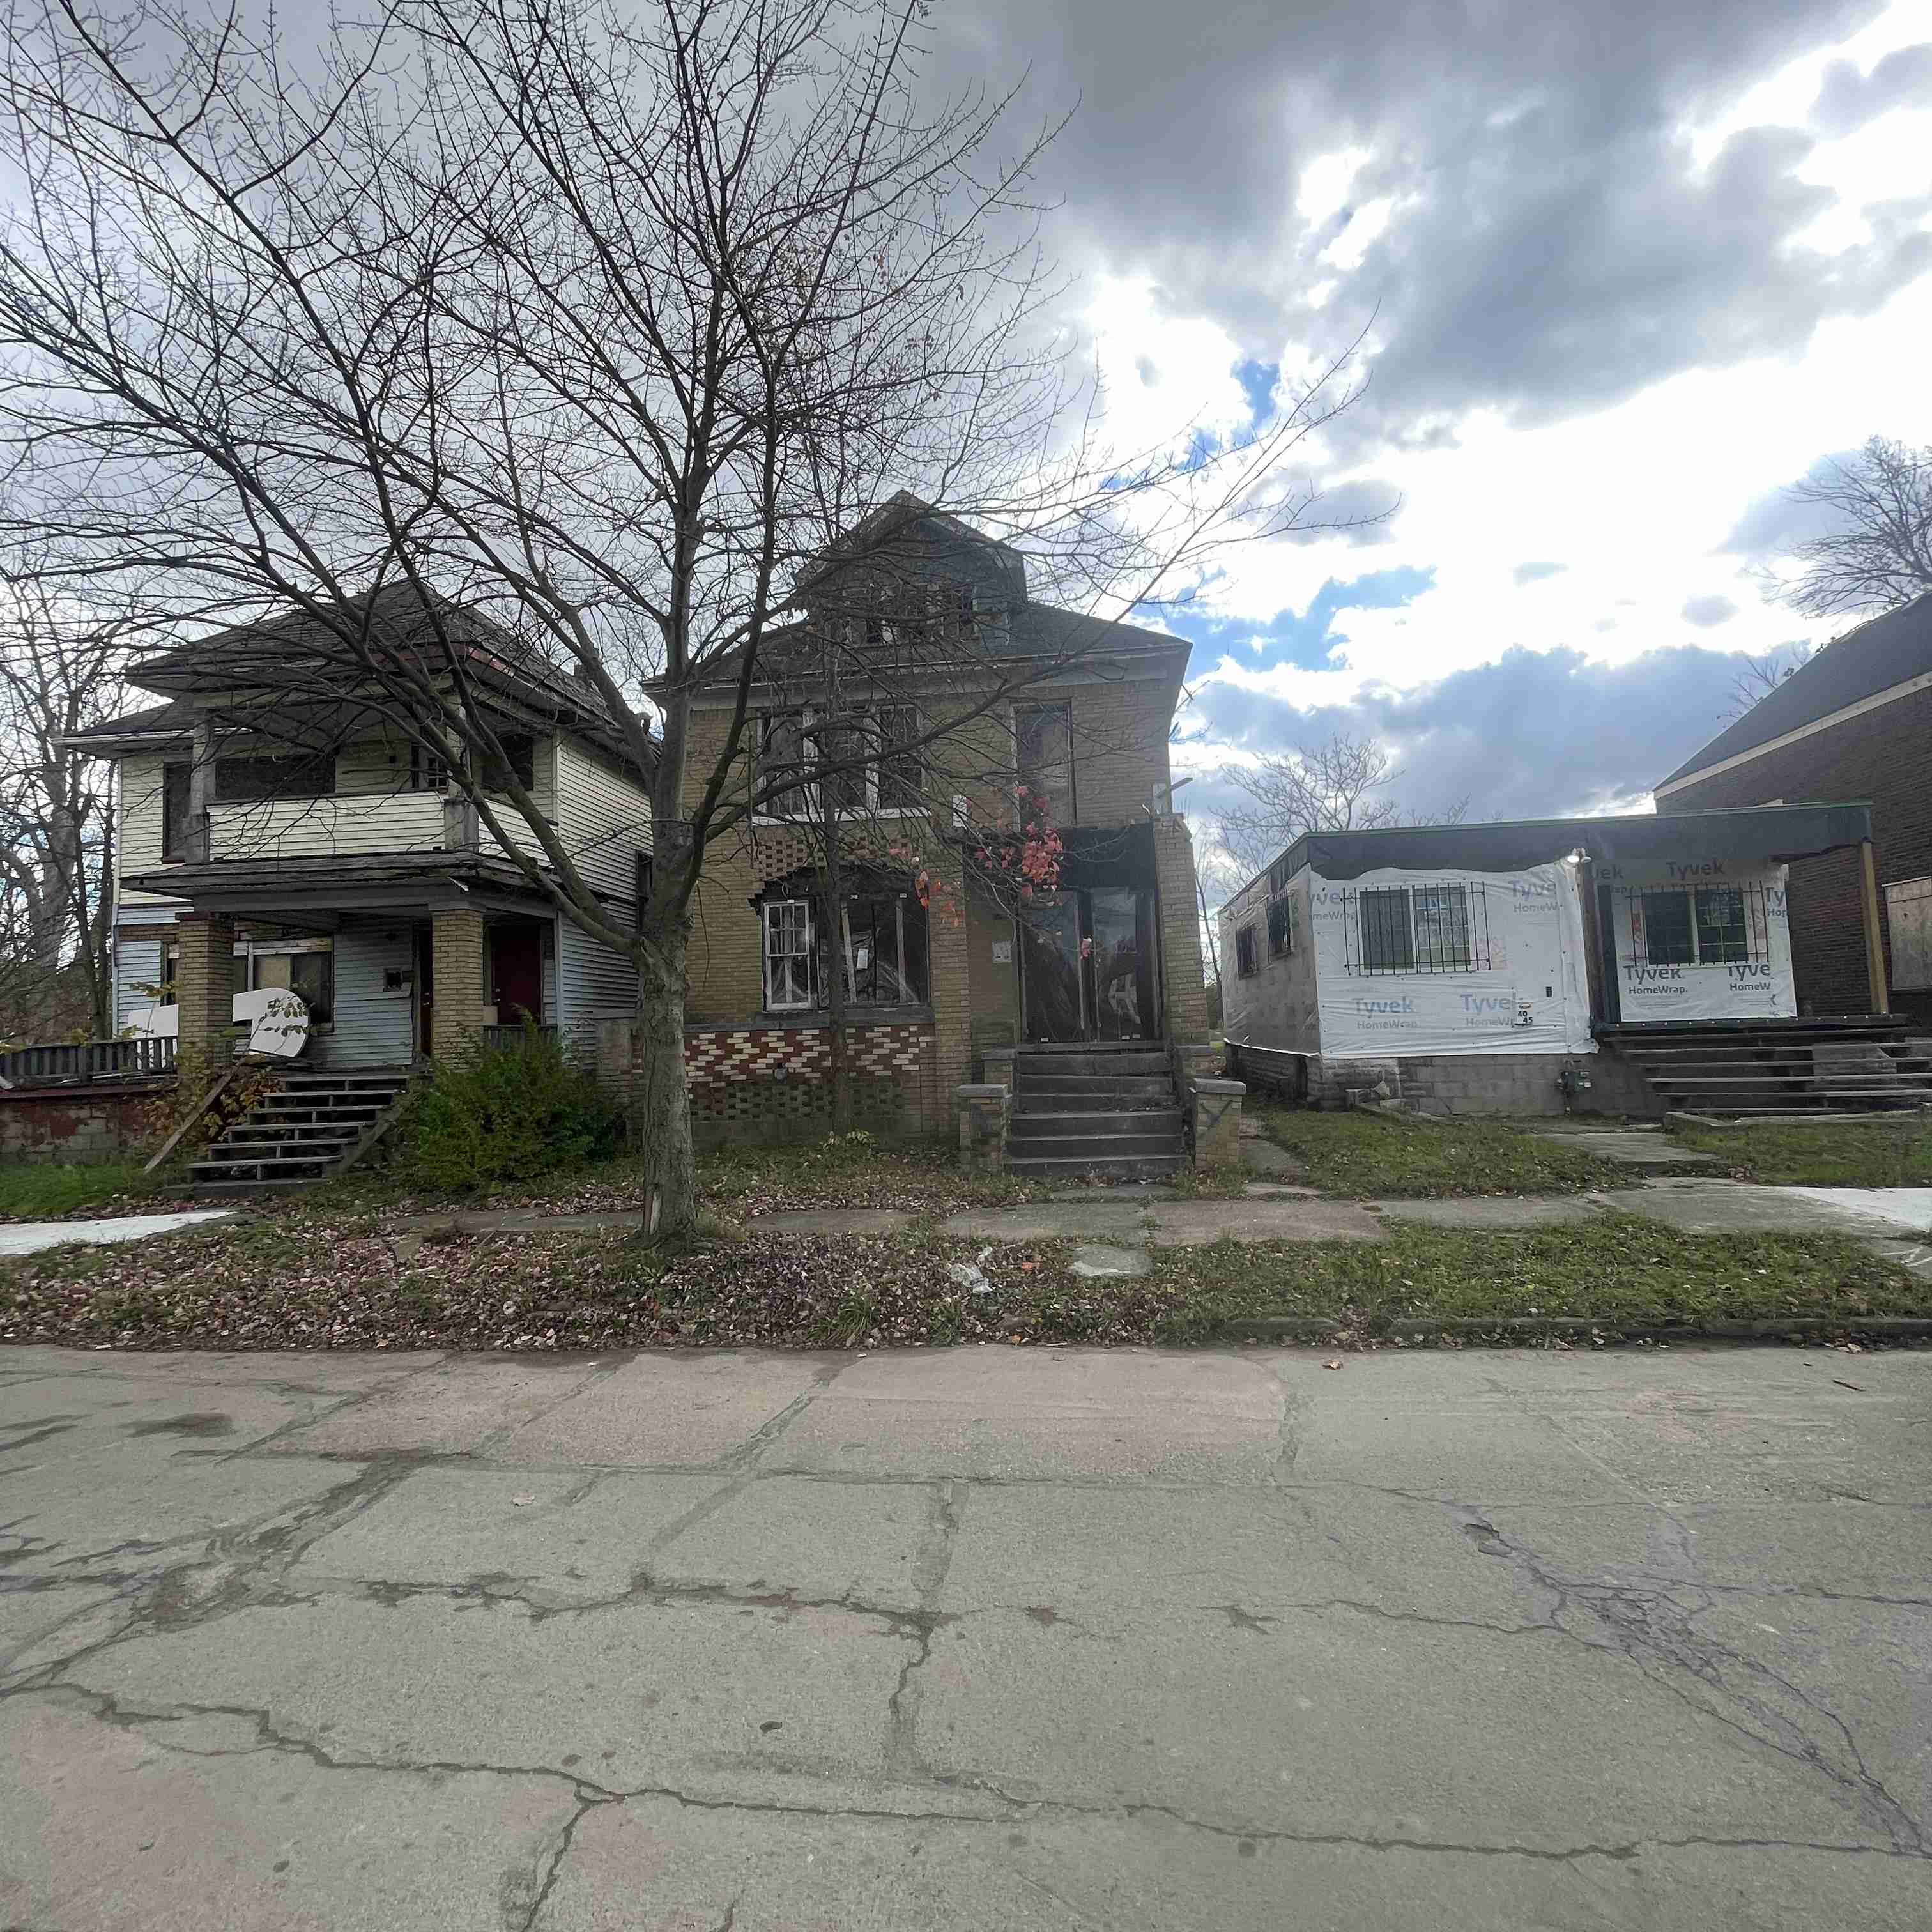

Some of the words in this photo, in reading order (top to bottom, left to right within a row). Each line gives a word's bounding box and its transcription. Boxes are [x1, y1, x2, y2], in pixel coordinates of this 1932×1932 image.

[1666, 861, 1726, 880] Tyvek
[1624, 965, 1682, 985] Tyvek
[1351, 995, 1414, 1018] Tyvek
